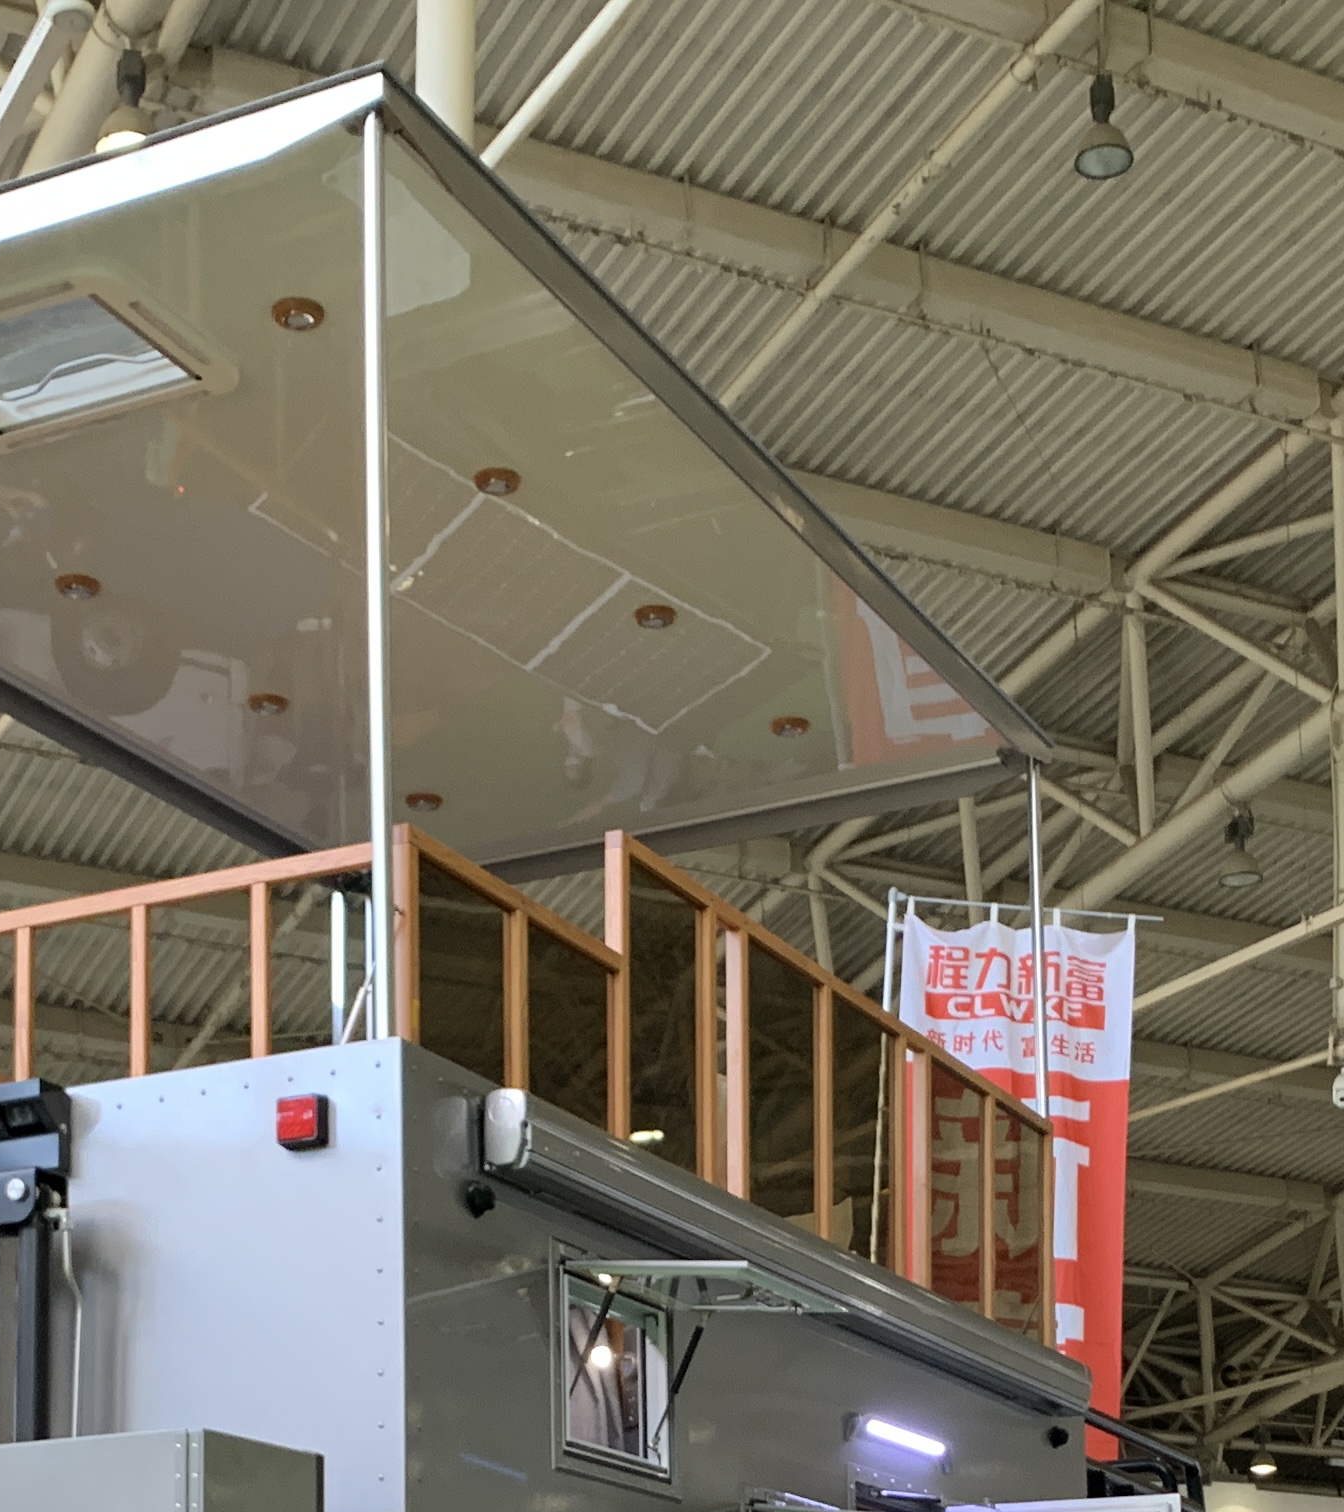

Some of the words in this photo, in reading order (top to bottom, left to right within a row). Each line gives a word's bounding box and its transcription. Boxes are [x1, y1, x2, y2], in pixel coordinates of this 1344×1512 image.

[926, 945, 1107, 1002] 程力新富
[926, 1028, 1005, 1055] 新时代
